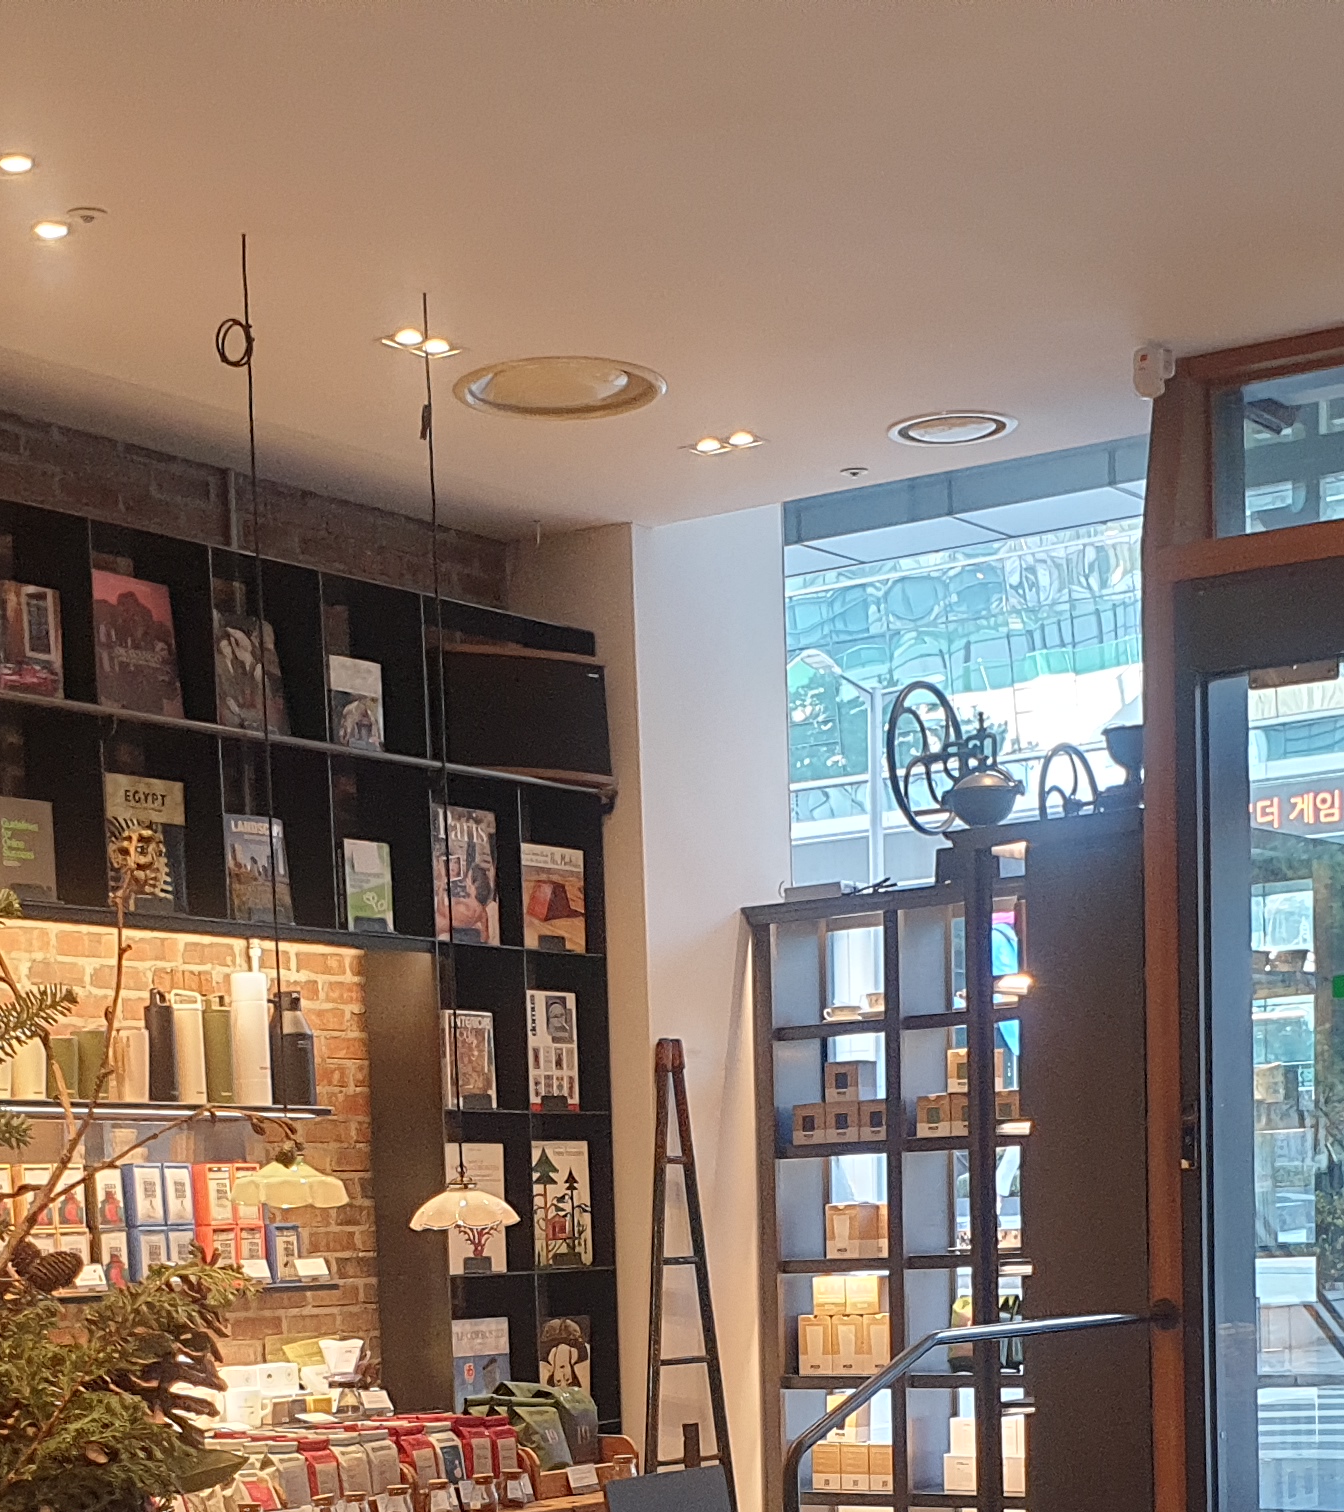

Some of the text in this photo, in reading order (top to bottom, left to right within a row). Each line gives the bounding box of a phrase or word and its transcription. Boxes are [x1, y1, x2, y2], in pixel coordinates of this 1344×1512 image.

[124, 789, 168, 807] EGYPT
[1289, 789, 1341, 825] 게임
[437, 808, 487, 842] Paris
[529, 994, 537, 1037] domus
